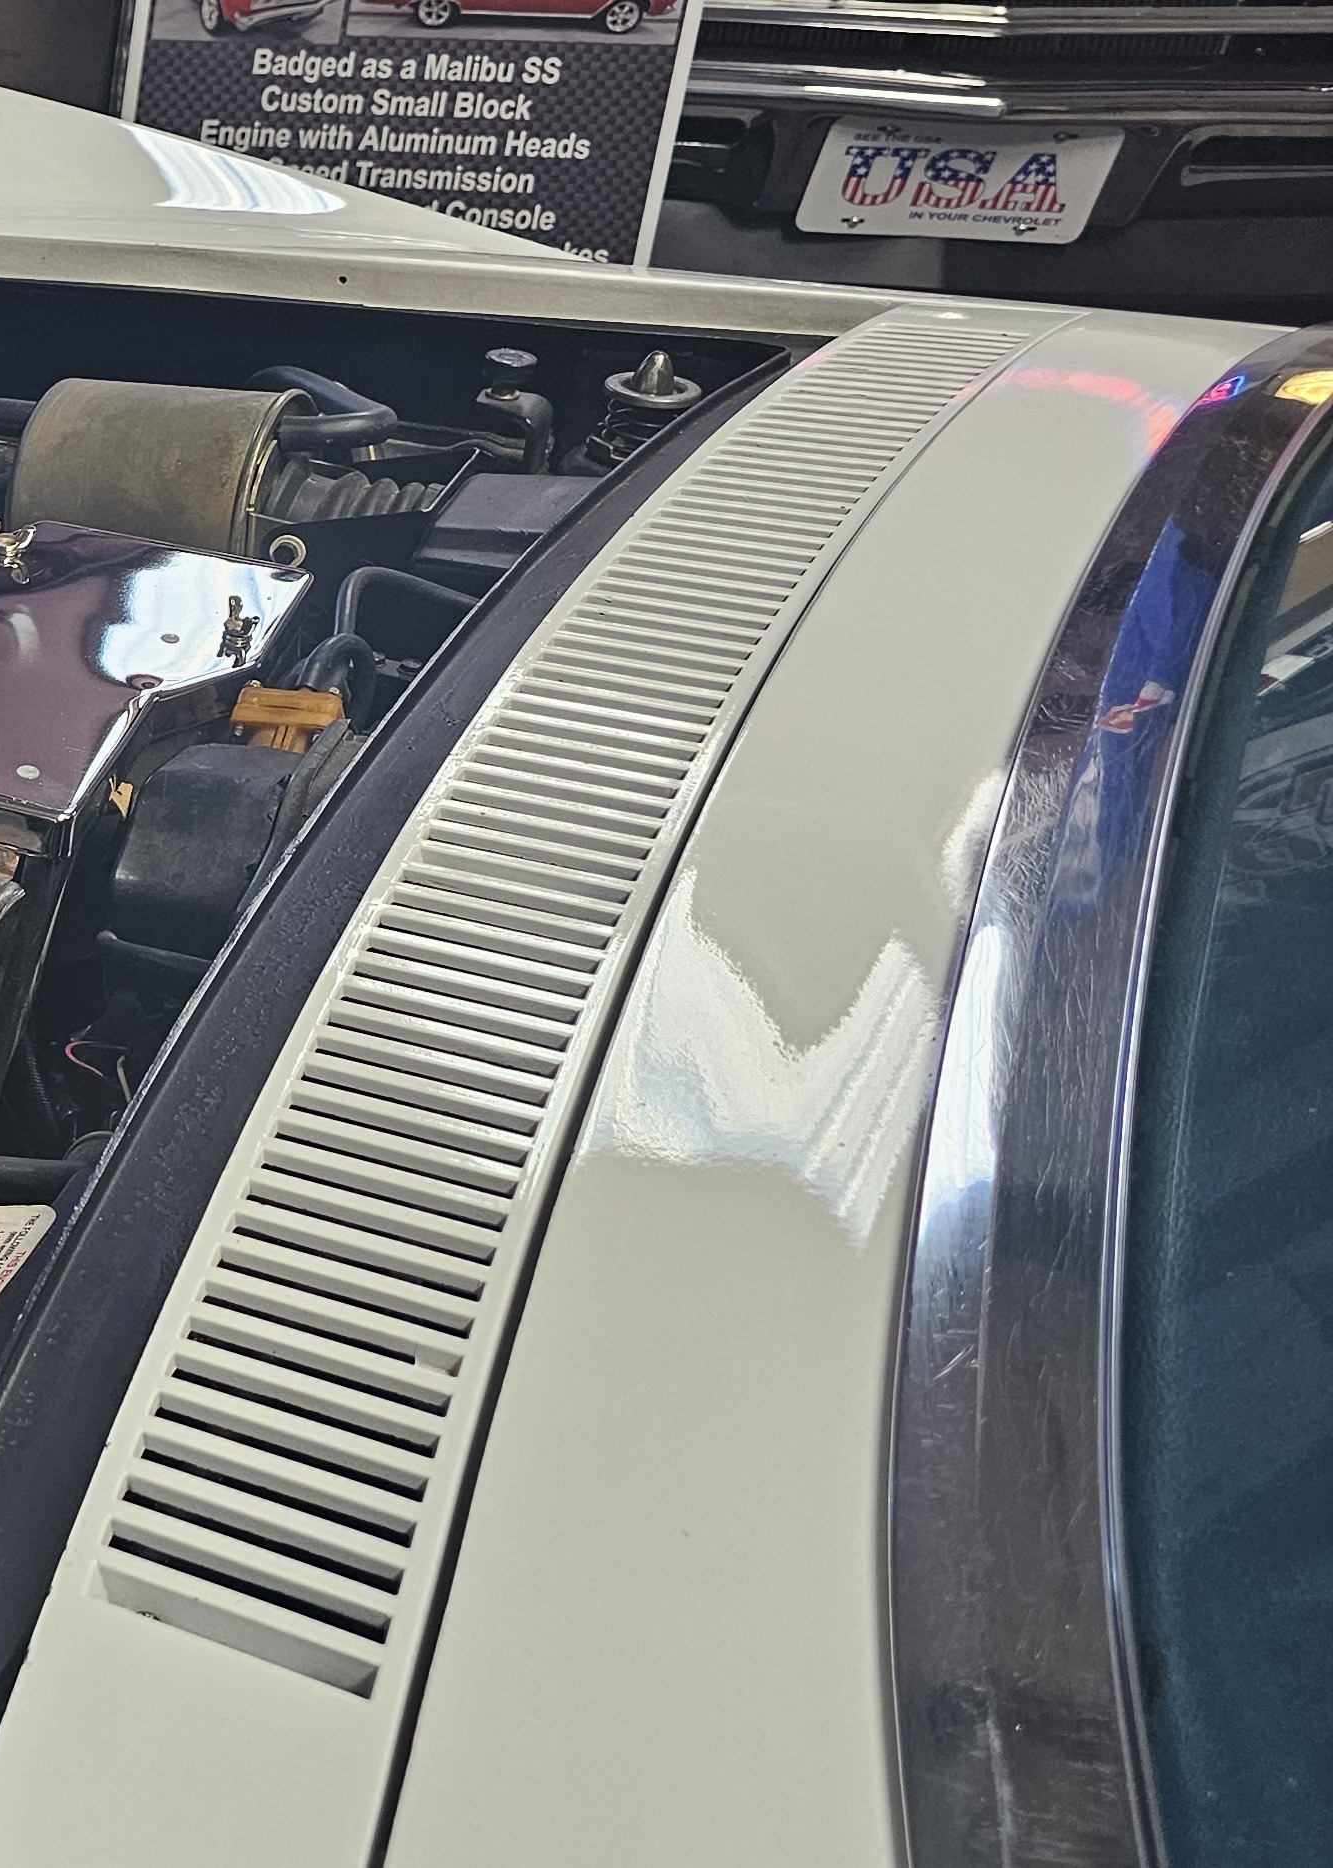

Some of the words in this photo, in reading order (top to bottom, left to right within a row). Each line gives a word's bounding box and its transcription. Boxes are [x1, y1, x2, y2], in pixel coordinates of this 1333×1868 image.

[252, 48, 356, 83] Badged
[360, 57, 393, 79] as
[399, 58, 417, 80] a
[424, 53, 515, 82] Malibu
[521, 56, 563, 84] SS
[261, 85, 364, 115] Custom
[370, 88, 448, 117] Small
[453, 91, 533, 120] Block
[200, 118, 292, 152] Engine
[298, 123, 354, 150] with
[358, 125, 497, 155] Aluminum
[504, 130, 591, 160] Heads
[853, 133, 877, 142] SEE
[882, 135, 911, 143] THE
[914, 136, 942, 144] USA
[356, 160, 534, 194] Transmission
[841, 145, 1066, 214] USA
[445, 200, 556, 231] Console
[908, 211, 923, 220] IN
[928, 212, 968, 222] YOUR
[972, 213, 1062, 227] CHEVROLET
[25, 1214, 40, 1225] THE
[6, 1250, 26, 1267] THIS
